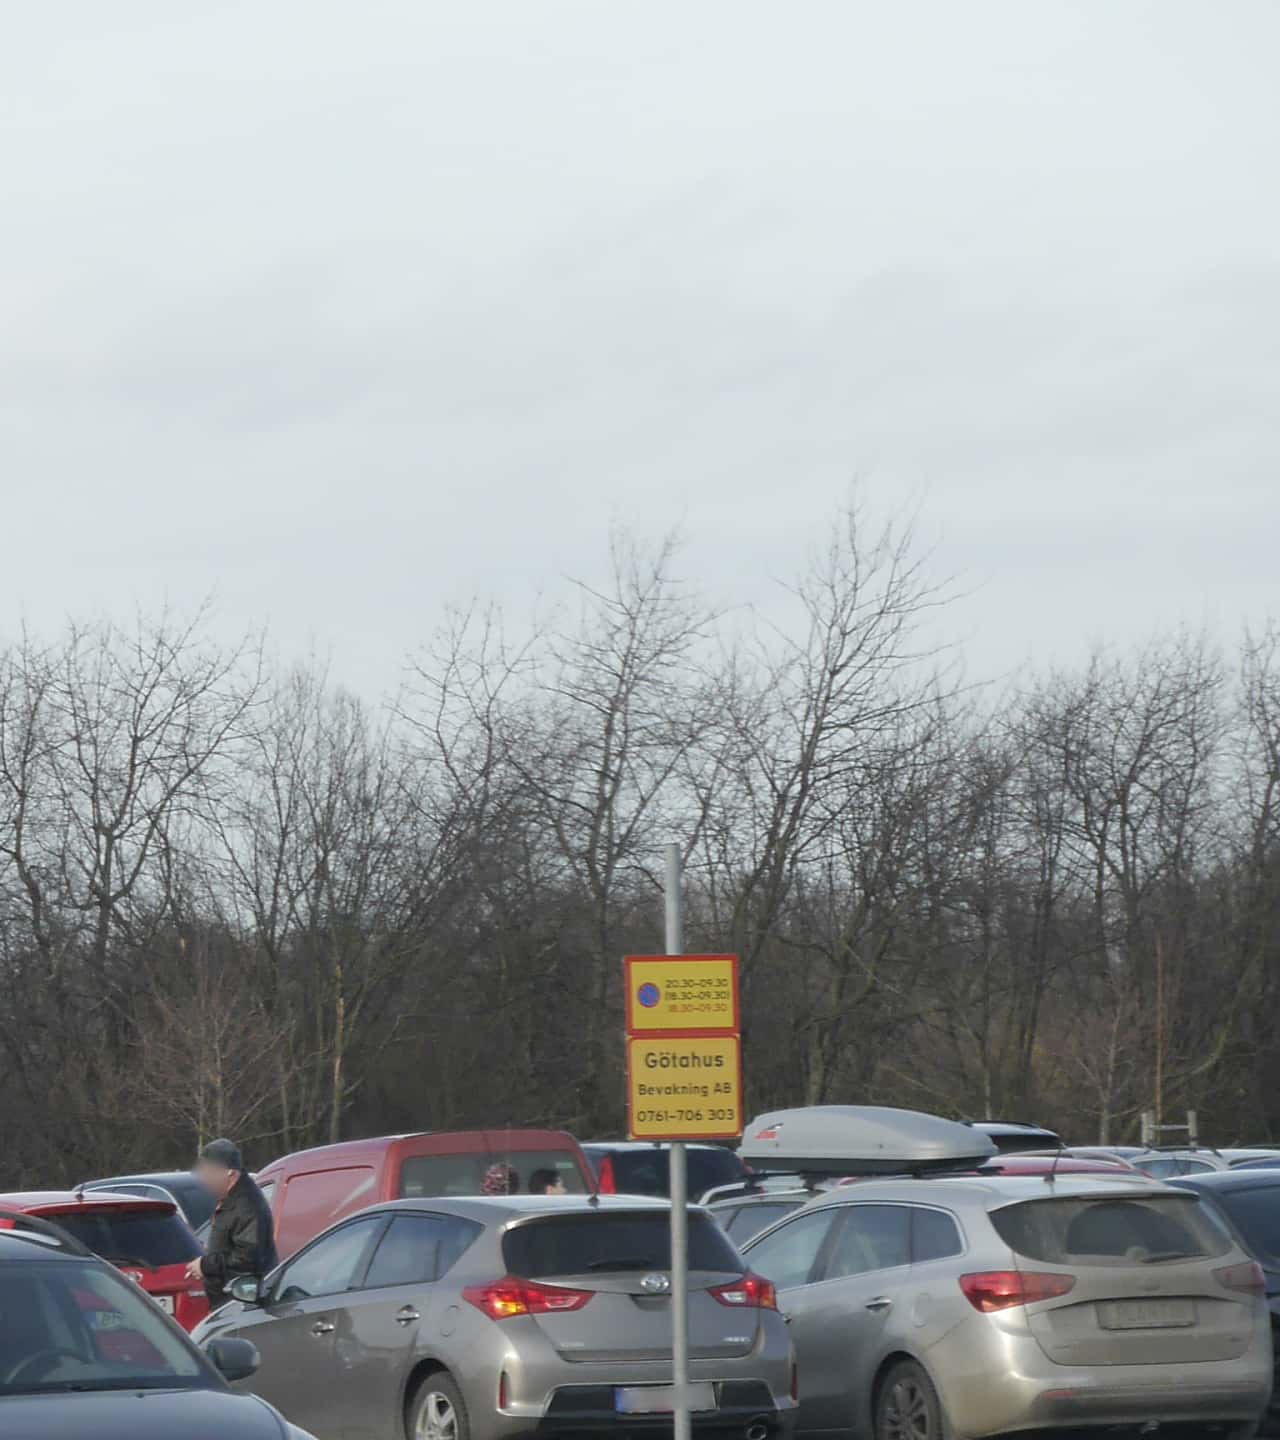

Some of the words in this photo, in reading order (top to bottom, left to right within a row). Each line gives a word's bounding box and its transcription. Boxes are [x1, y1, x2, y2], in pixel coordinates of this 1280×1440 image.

[644, 1051, 725, 1069] Götahus
[638, 1083, 709, 1097] Bevakning
[714, 1082, 732, 1094] AB
[637, 1109, 703, 1122] 0761-706
[707, 1108, 735, 1121] 303
